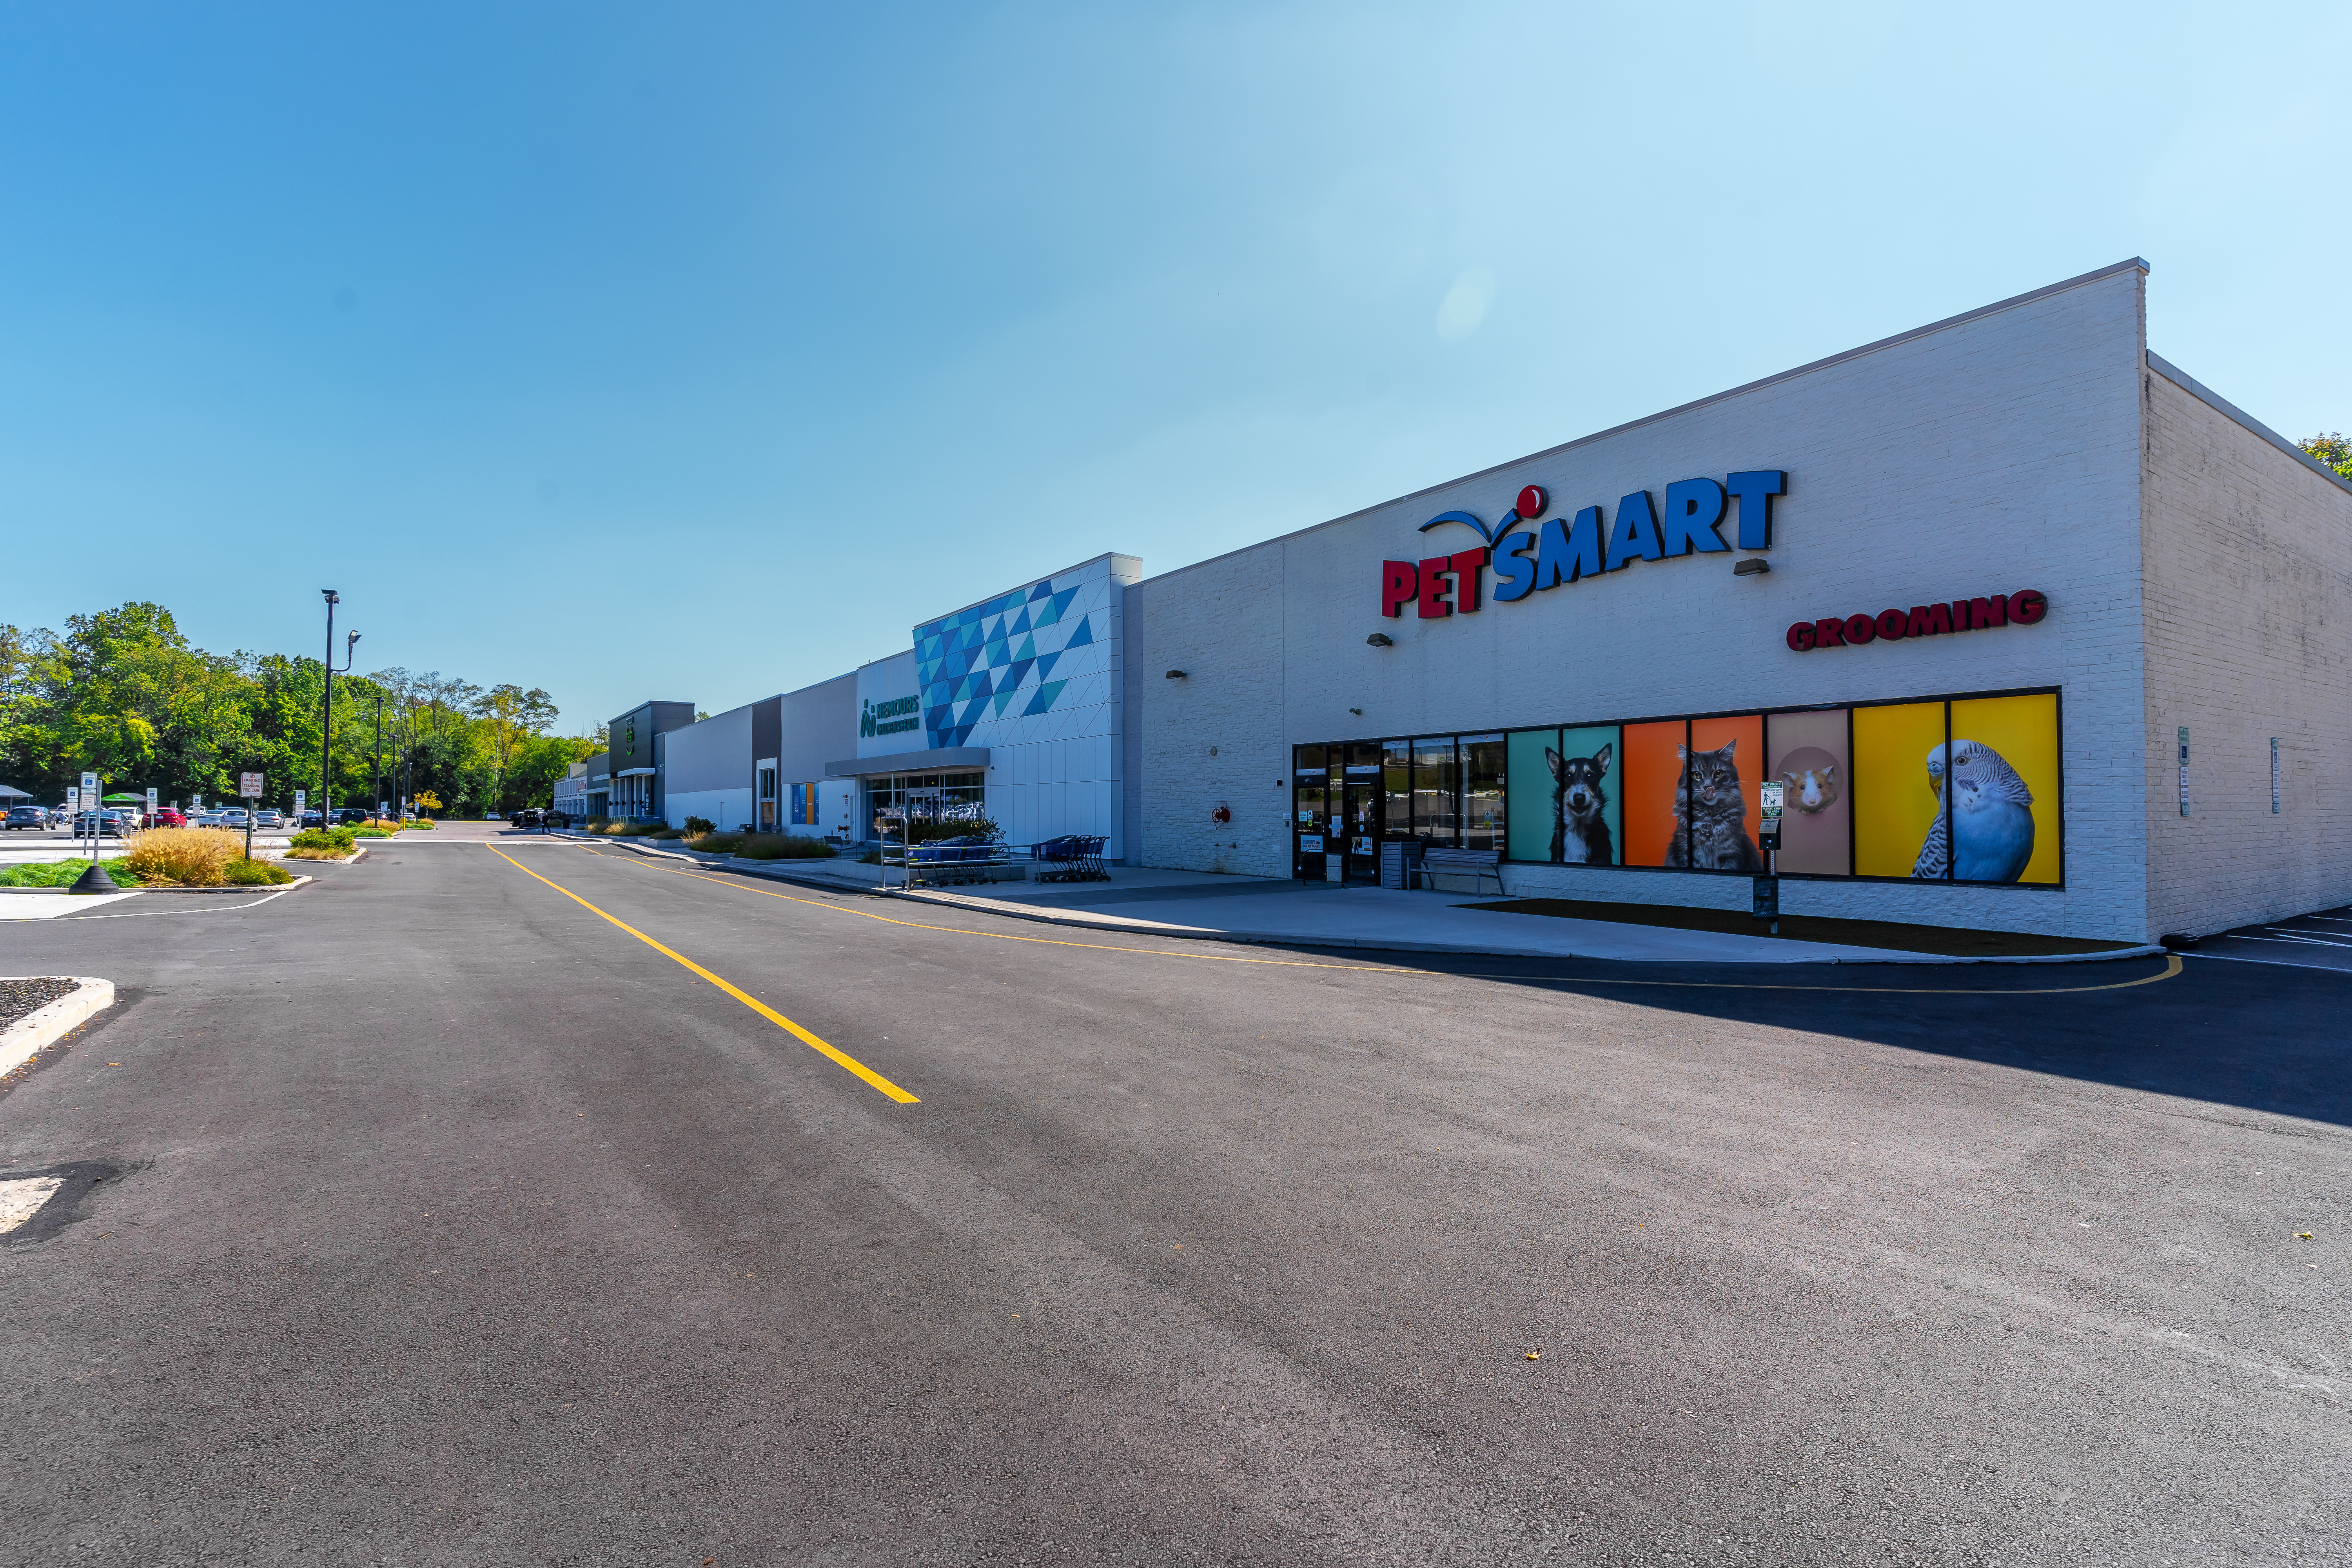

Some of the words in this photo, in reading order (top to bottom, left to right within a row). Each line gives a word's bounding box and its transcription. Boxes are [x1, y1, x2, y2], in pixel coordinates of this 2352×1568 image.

[1786, 589, 2048, 652] GROOMING
[877, 695, 919, 720] NEMOURS
[900, 717, 919, 732] HEALTH
